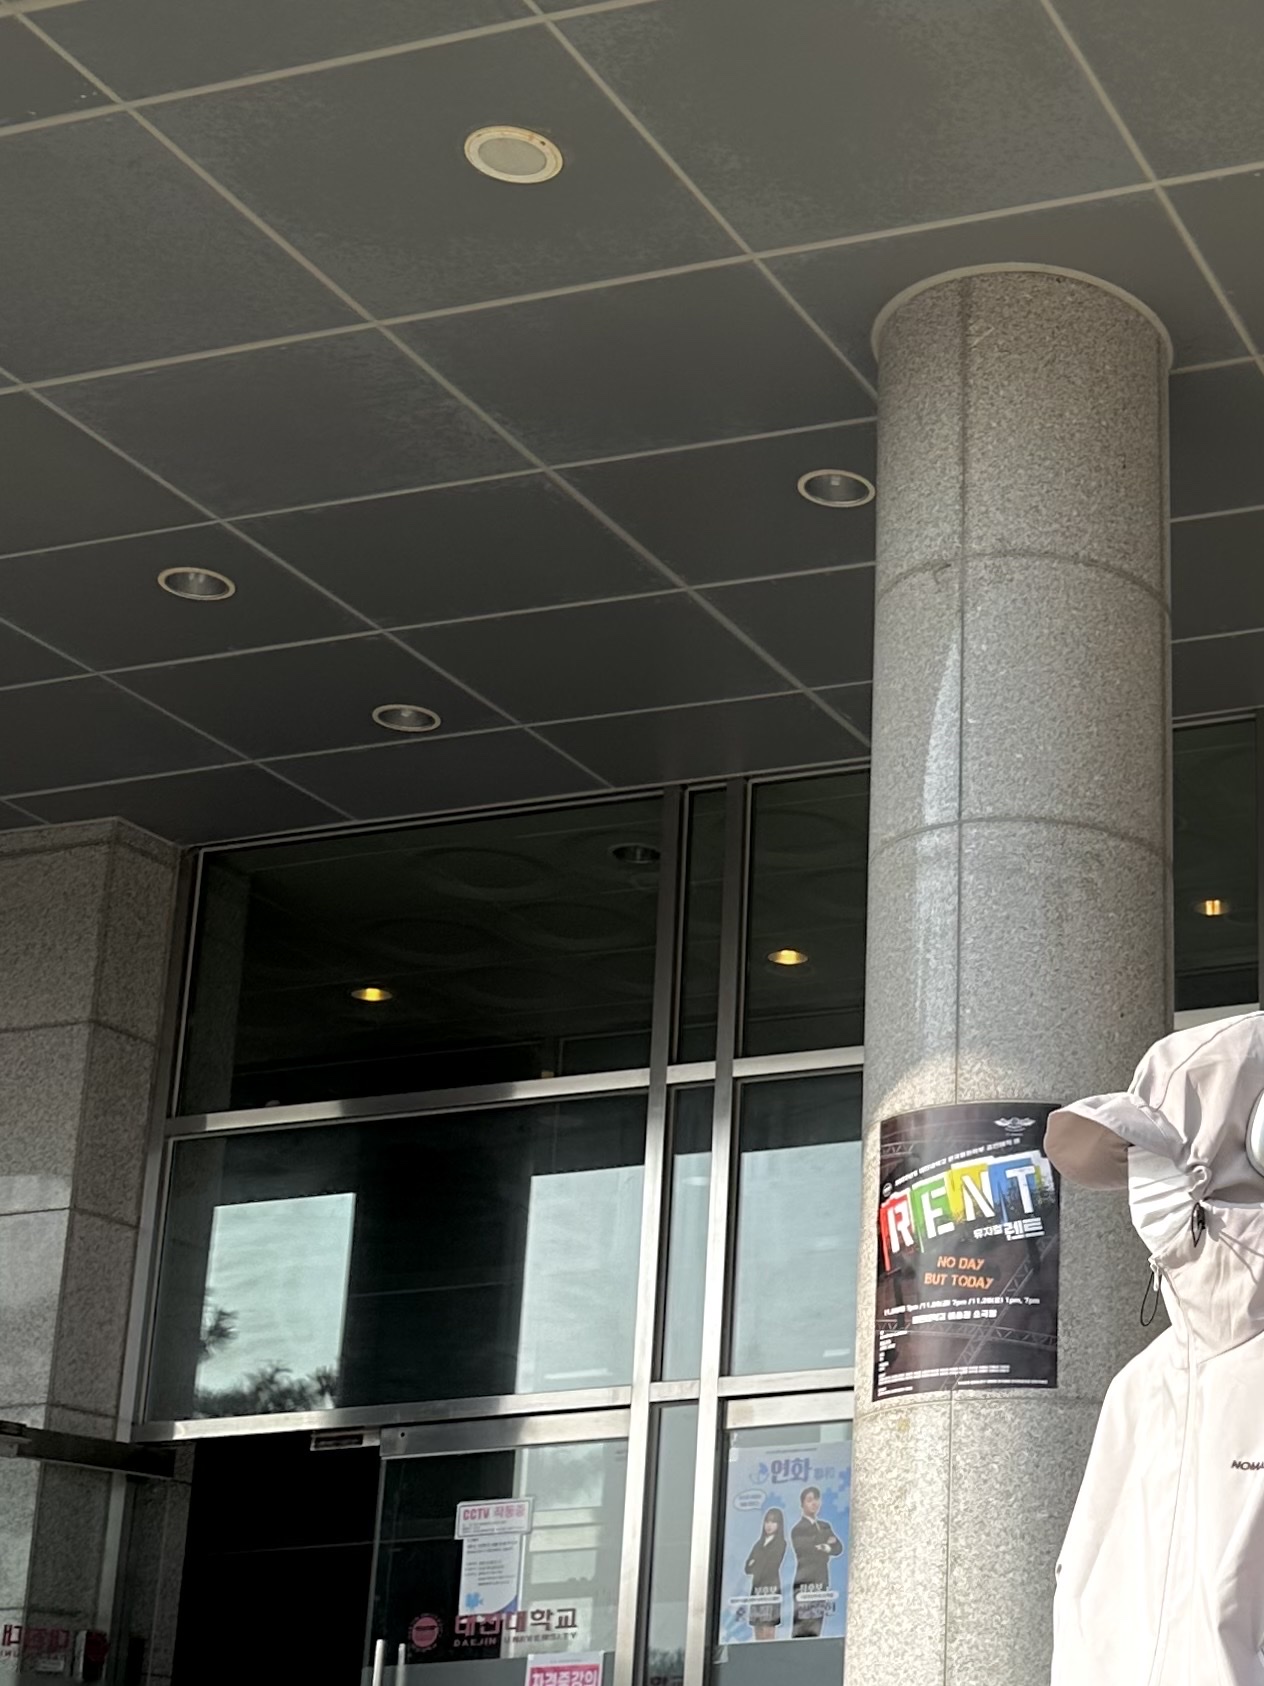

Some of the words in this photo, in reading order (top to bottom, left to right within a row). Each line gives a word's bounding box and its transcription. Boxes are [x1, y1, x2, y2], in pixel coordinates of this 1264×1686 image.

[883, 1163, 1038, 1254] RENT
[1003, 1217, 1044, 1236] 렌트
[937, 1255, 957, 1268] NO
[958, 1256, 985, 1271] DAY
[924, 1273, 948, 1287] BUT
[951, 1274, 994, 1290] TODAY
[463, 1507, 490, 1521] CCTV
[455, 1608, 578, 1636] 대진대학교
[453, 1638, 497, 1648] DAEJIN
[504, 1631, 578, 1644] UNIVERSITY
